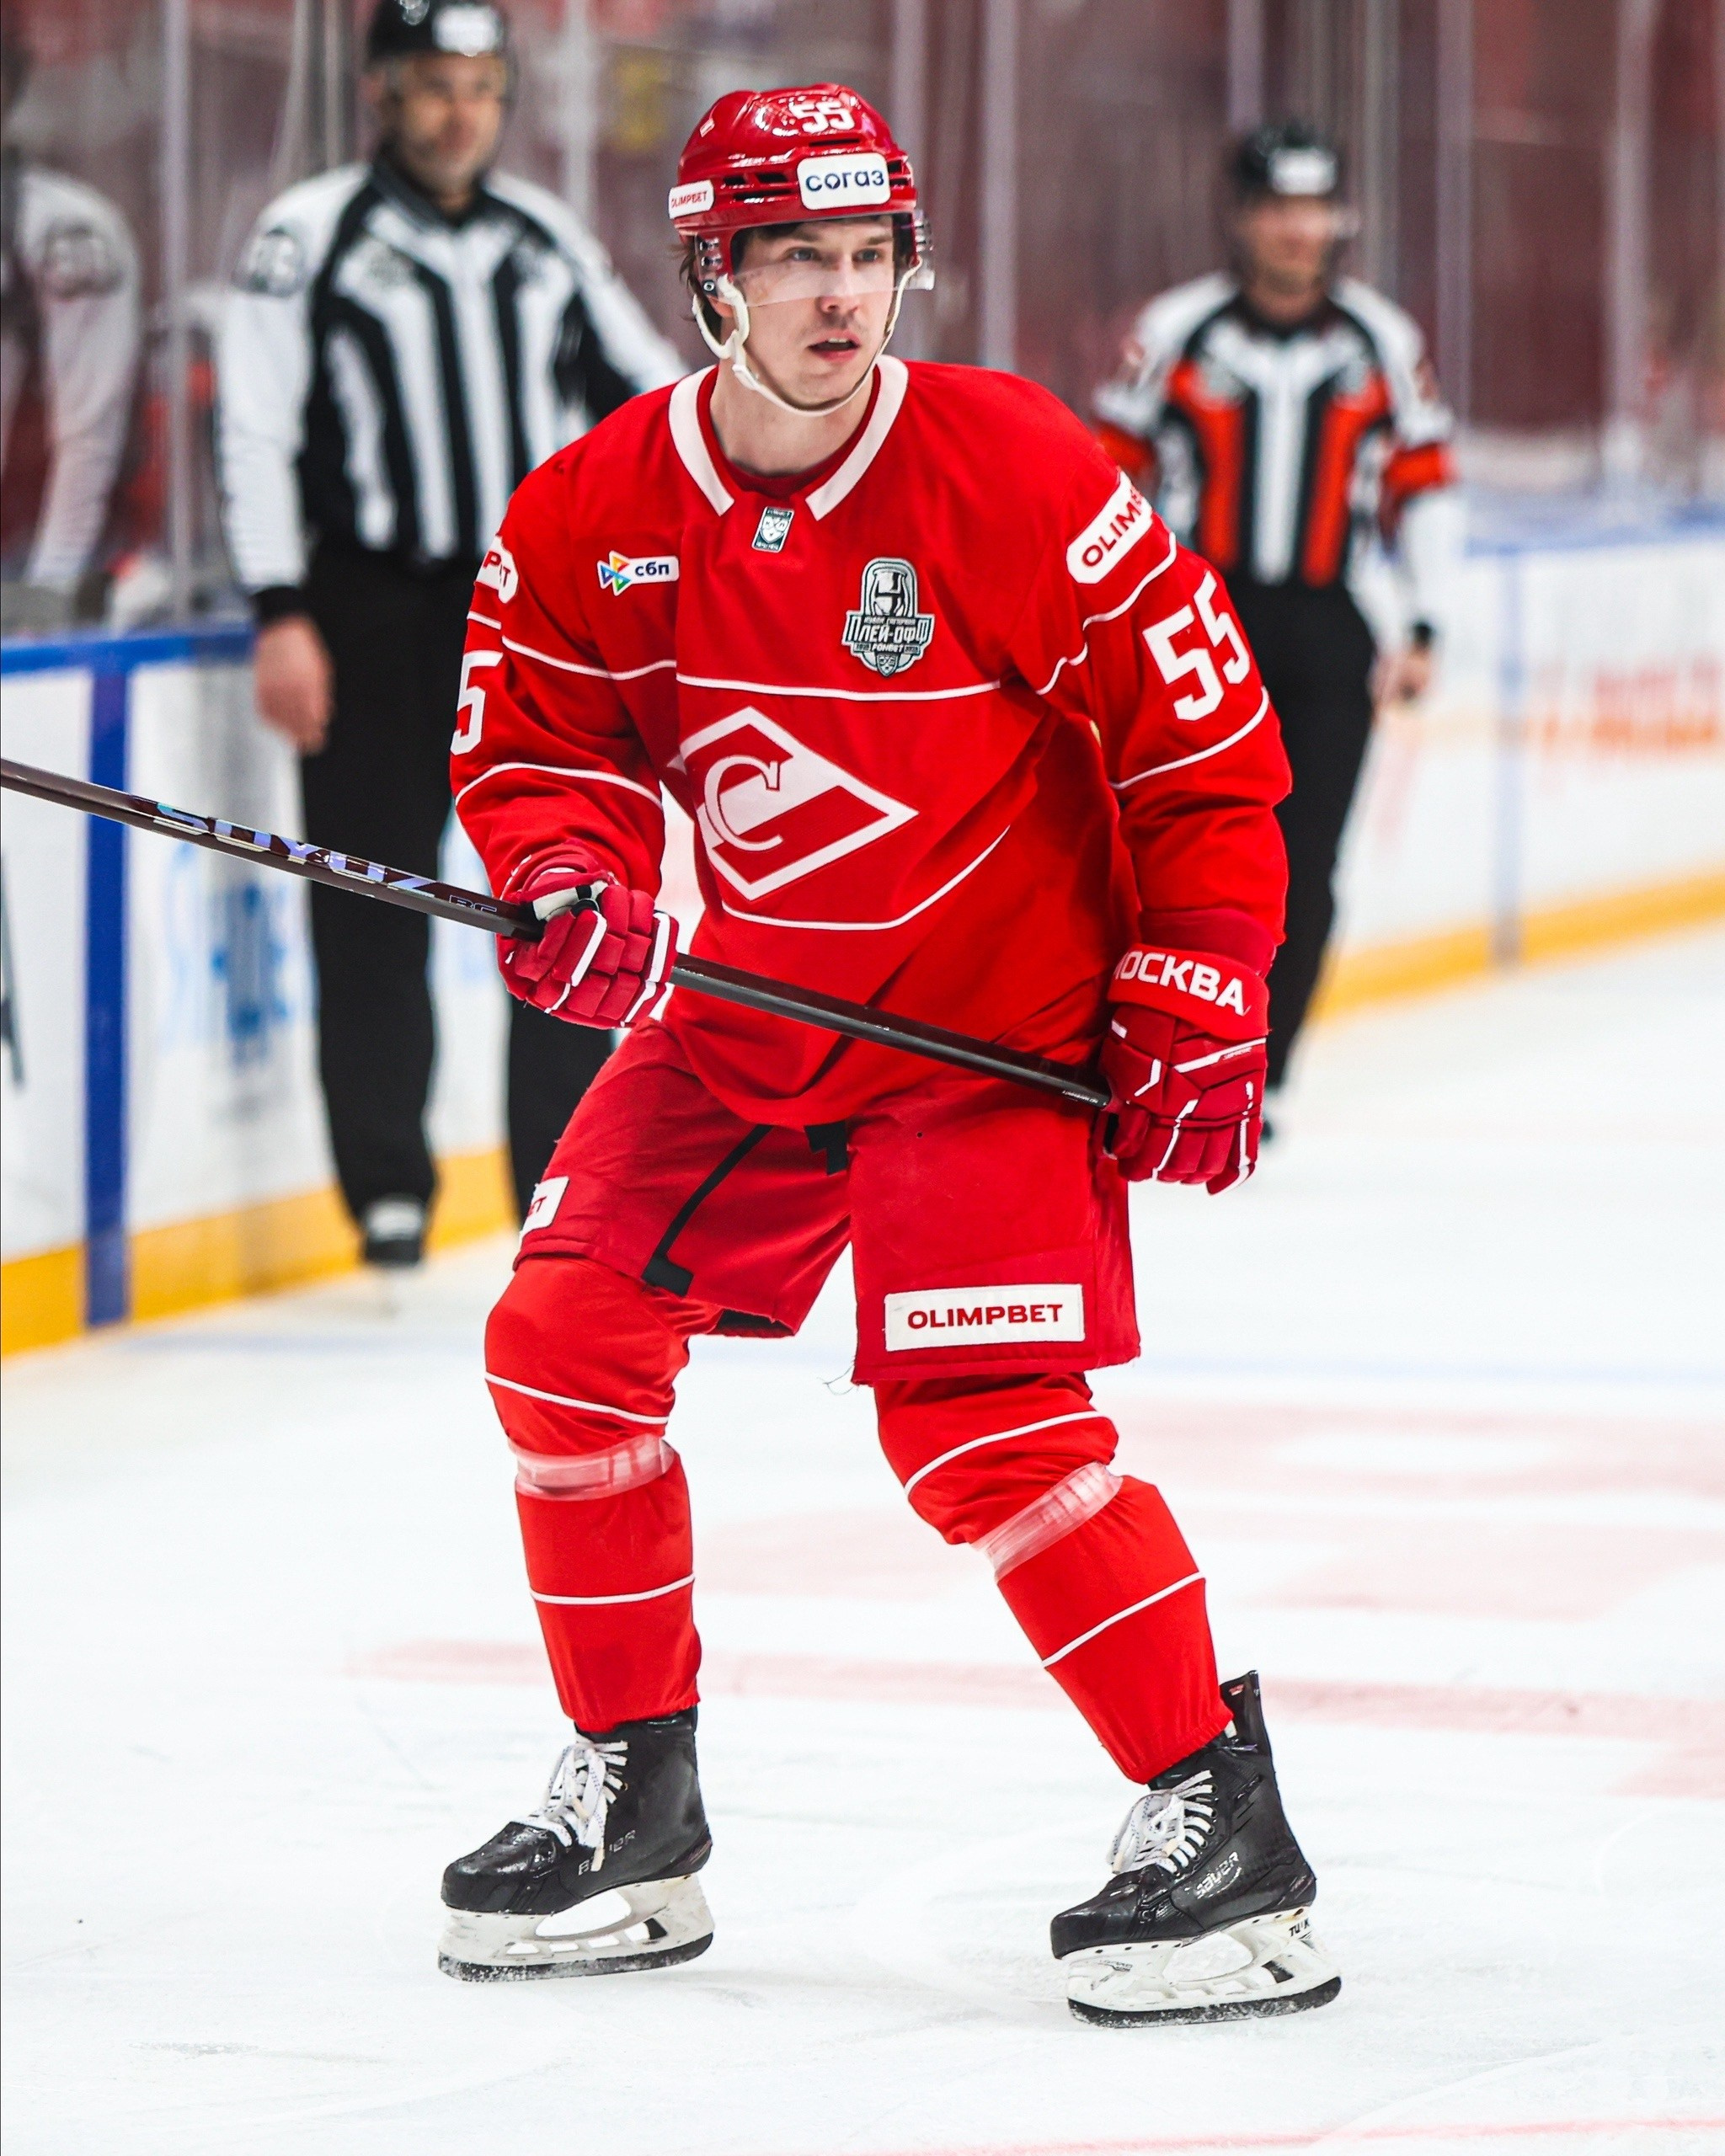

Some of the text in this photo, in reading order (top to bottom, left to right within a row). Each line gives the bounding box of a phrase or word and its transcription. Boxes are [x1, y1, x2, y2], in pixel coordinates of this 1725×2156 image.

[788, 100, 855, 133] 55
[1081, 493, 1142, 567] OLIM
[634, 561, 670, 577] сбп
[1142, 568, 1251, 721] 55
[907, 1304, 1063, 1329] OLIMPBET
[578, 1829, 636, 1876] BER
